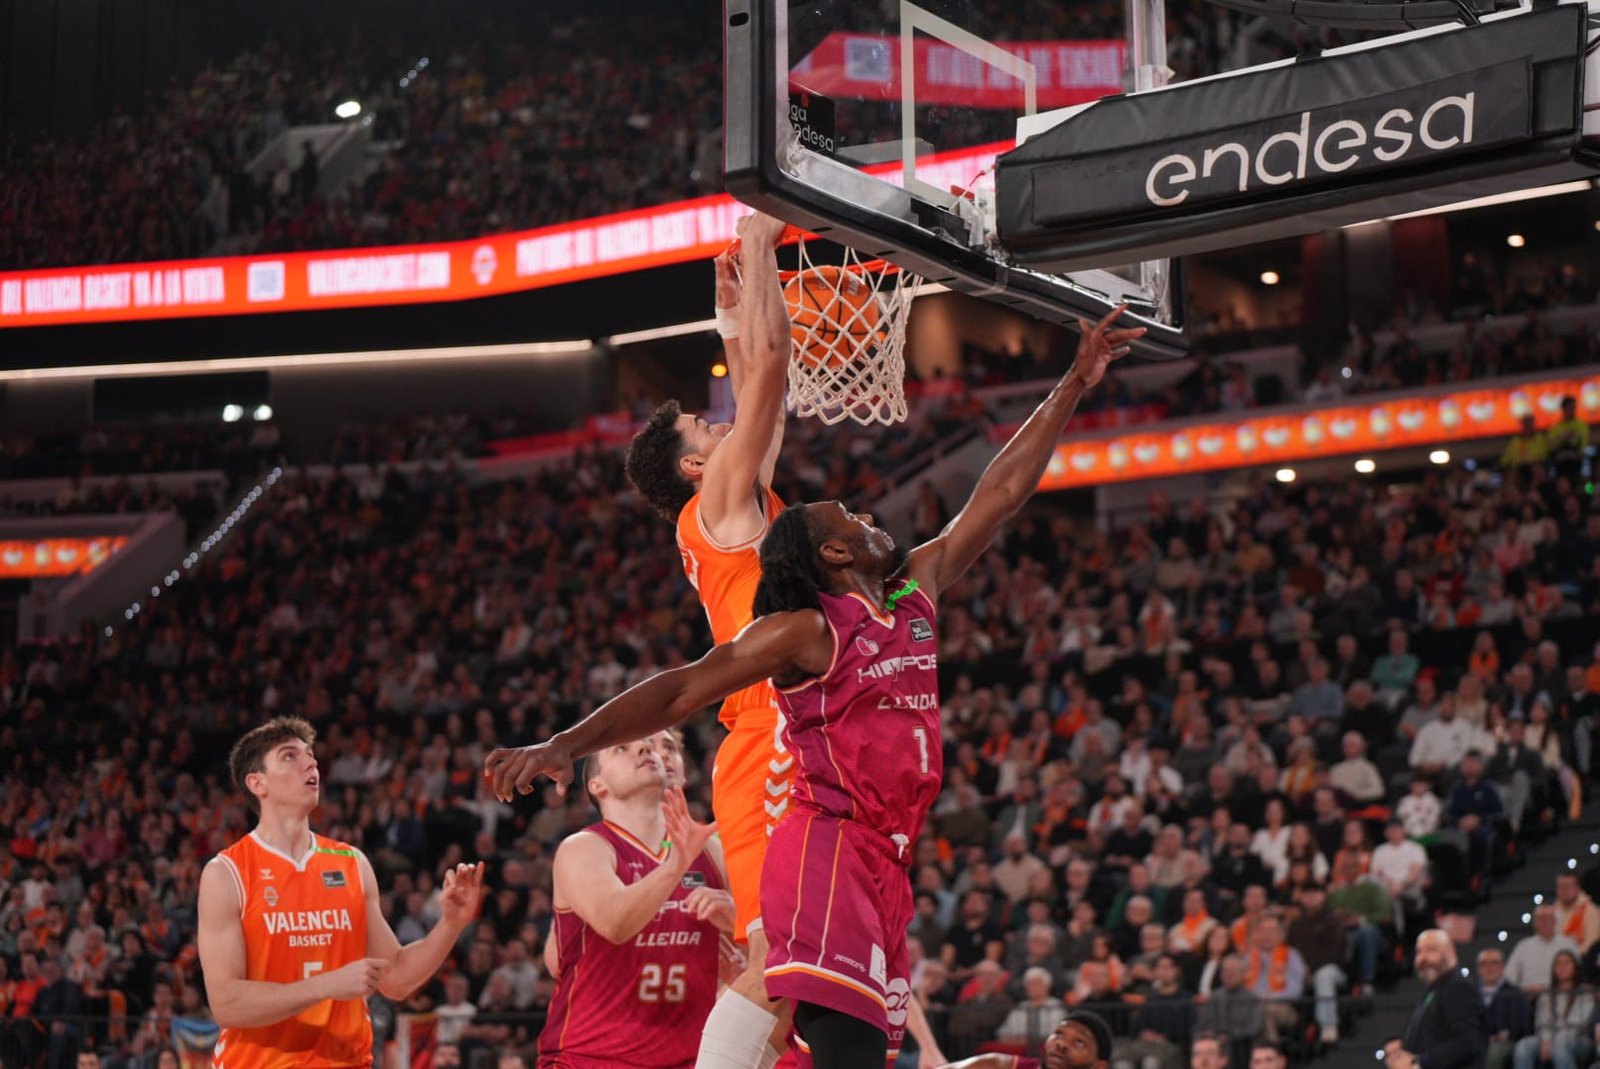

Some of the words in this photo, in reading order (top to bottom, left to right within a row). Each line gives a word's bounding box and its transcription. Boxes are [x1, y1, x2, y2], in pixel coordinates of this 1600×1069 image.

[790, 104, 807, 122] ga
[793, 122, 834, 153] ndesa
[1145, 91, 1475, 207] endesa
[912, 727, 929, 774] 1
[262, 908, 352, 934] VALENCIA
[288, 933, 333, 947] BASKET
[635, 931, 701, 947] LLEIDA
[638, 964, 686, 1002] 25
